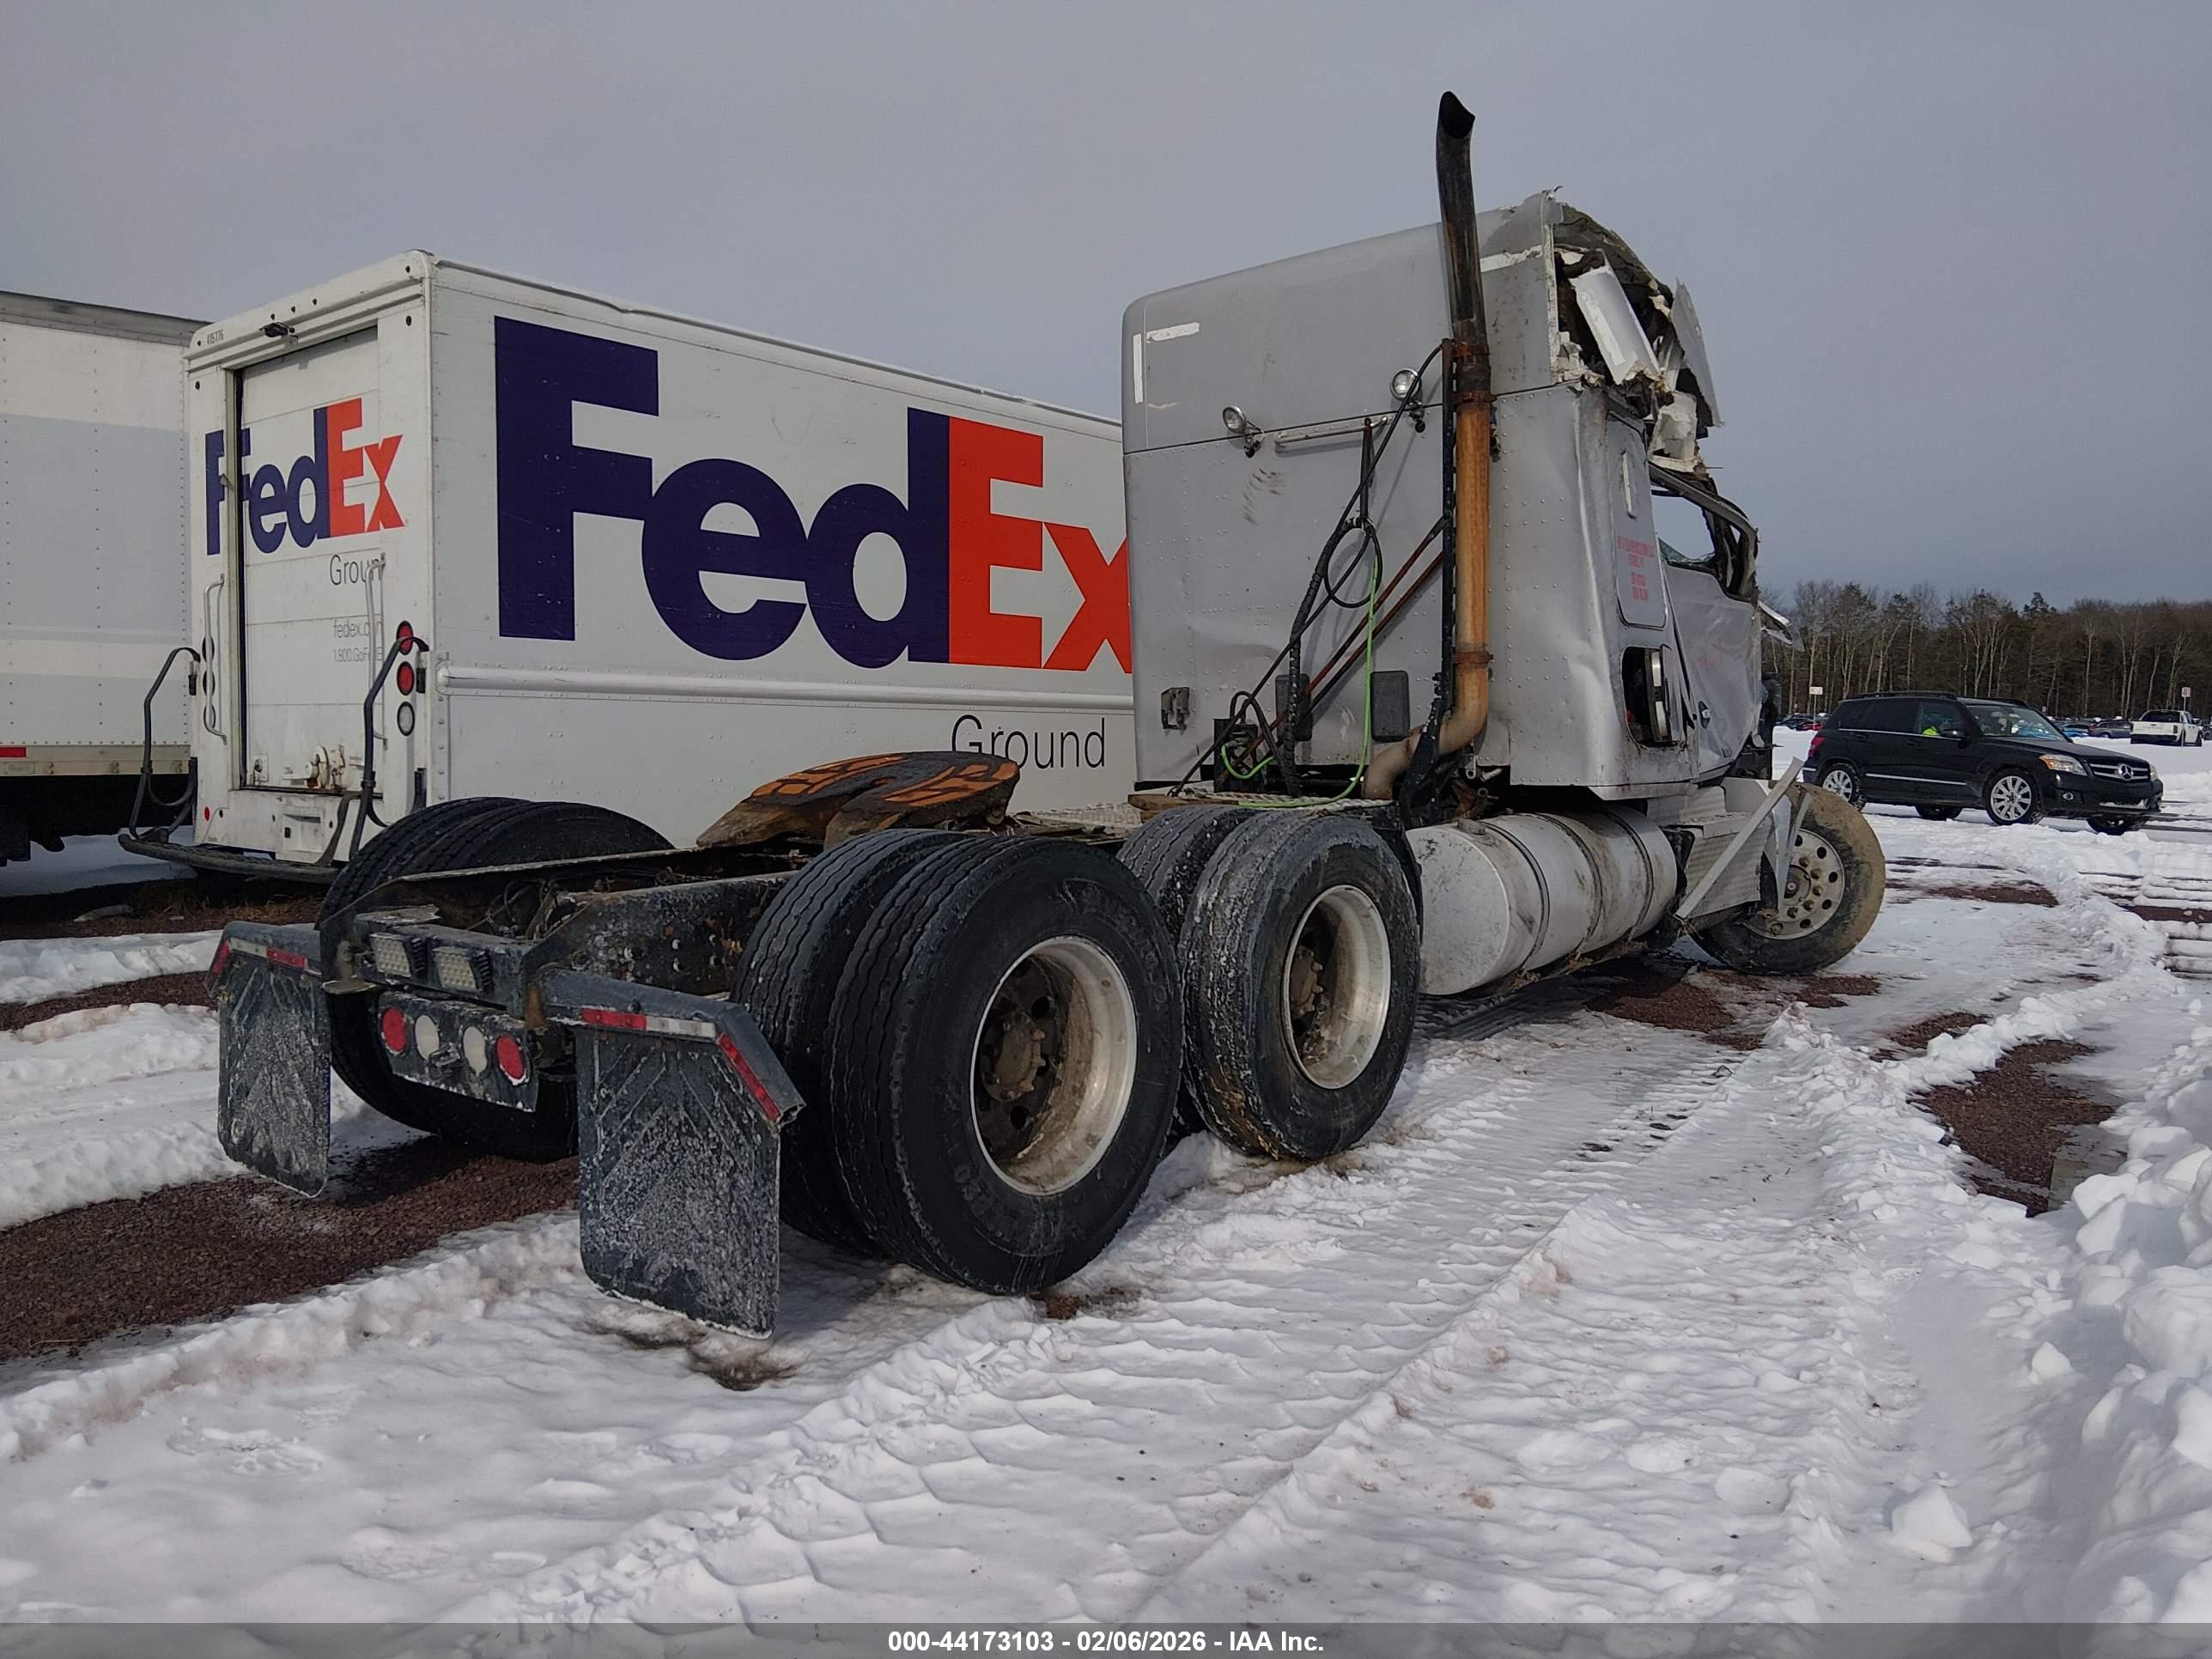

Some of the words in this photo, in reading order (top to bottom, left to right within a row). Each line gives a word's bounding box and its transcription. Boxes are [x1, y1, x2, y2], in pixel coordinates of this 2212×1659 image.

[205, 398, 406, 554] FedEx
[494, 315, 1133, 674] FedEx
[329, 554, 384, 586] Groun
[951, 714, 1106, 770] Ground
